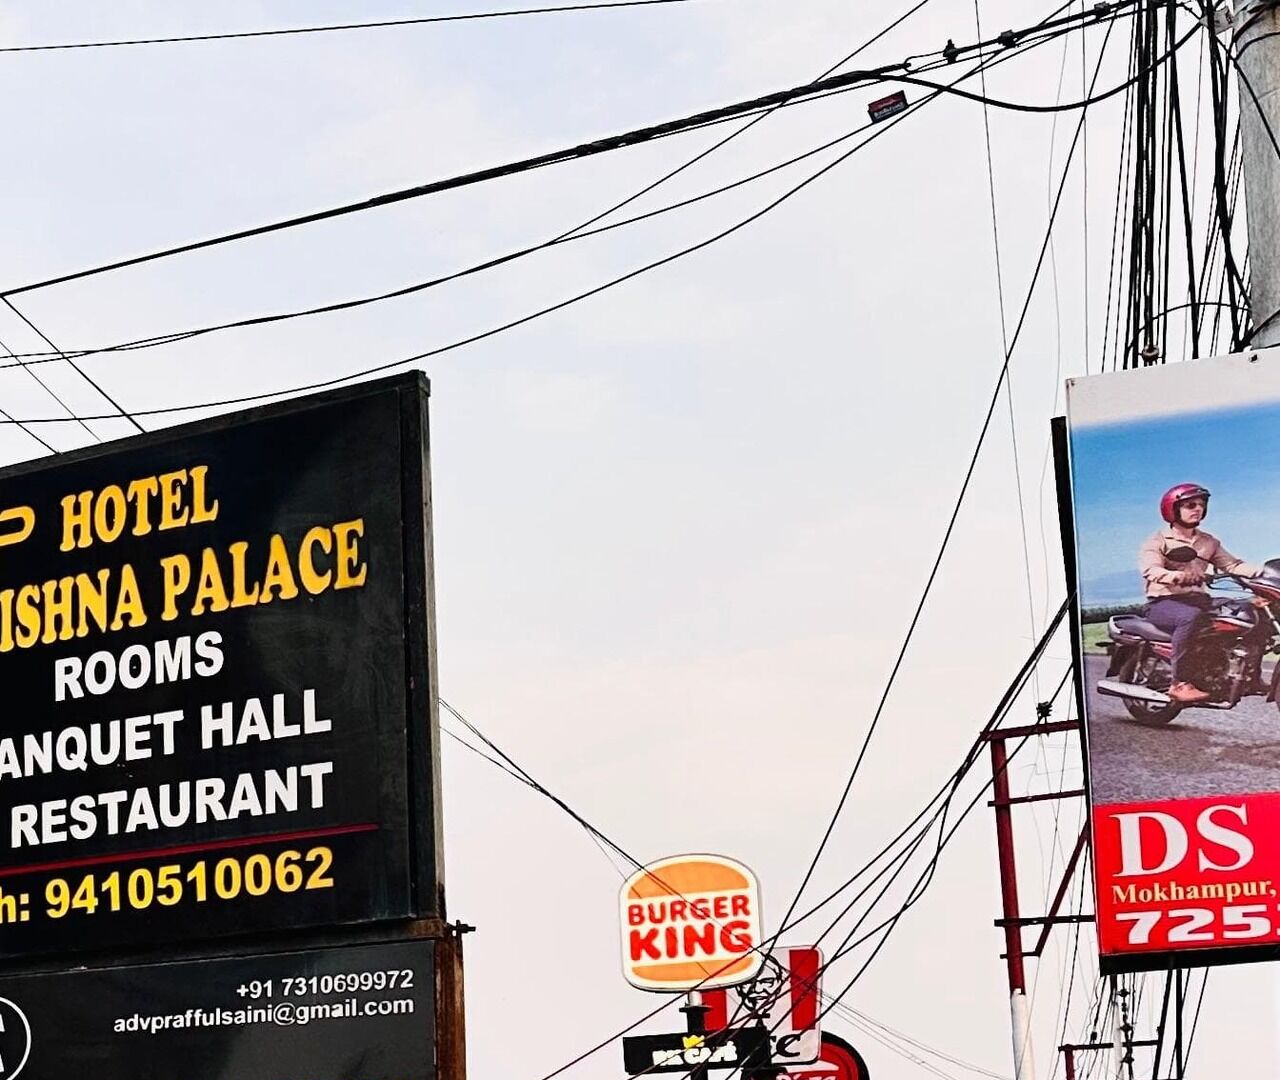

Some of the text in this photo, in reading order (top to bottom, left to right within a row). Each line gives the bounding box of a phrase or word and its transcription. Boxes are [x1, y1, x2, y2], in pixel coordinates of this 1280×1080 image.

[60, 464, 220, 553] HOTEL
[160, 517, 368, 623] PALACE
[53, 630, 225, 702] ROOMS
[200, 688, 333, 750] HALL
[10, 761, 335, 848] RESTAURANT
[1112, 803, 1255, 879] DS
[45, 846, 335, 920] 9410510062
[627, 894, 752, 927] BURGER
[1111, 877, 1277, 907] Mokhampur,
[628, 920, 753, 962] KING
[1115, 902, 1280, 945] 725
[236, 968, 415, 1000] +91 7310699972
[112, 997, 415, 1034] advpraffulsaini@gmail.com
